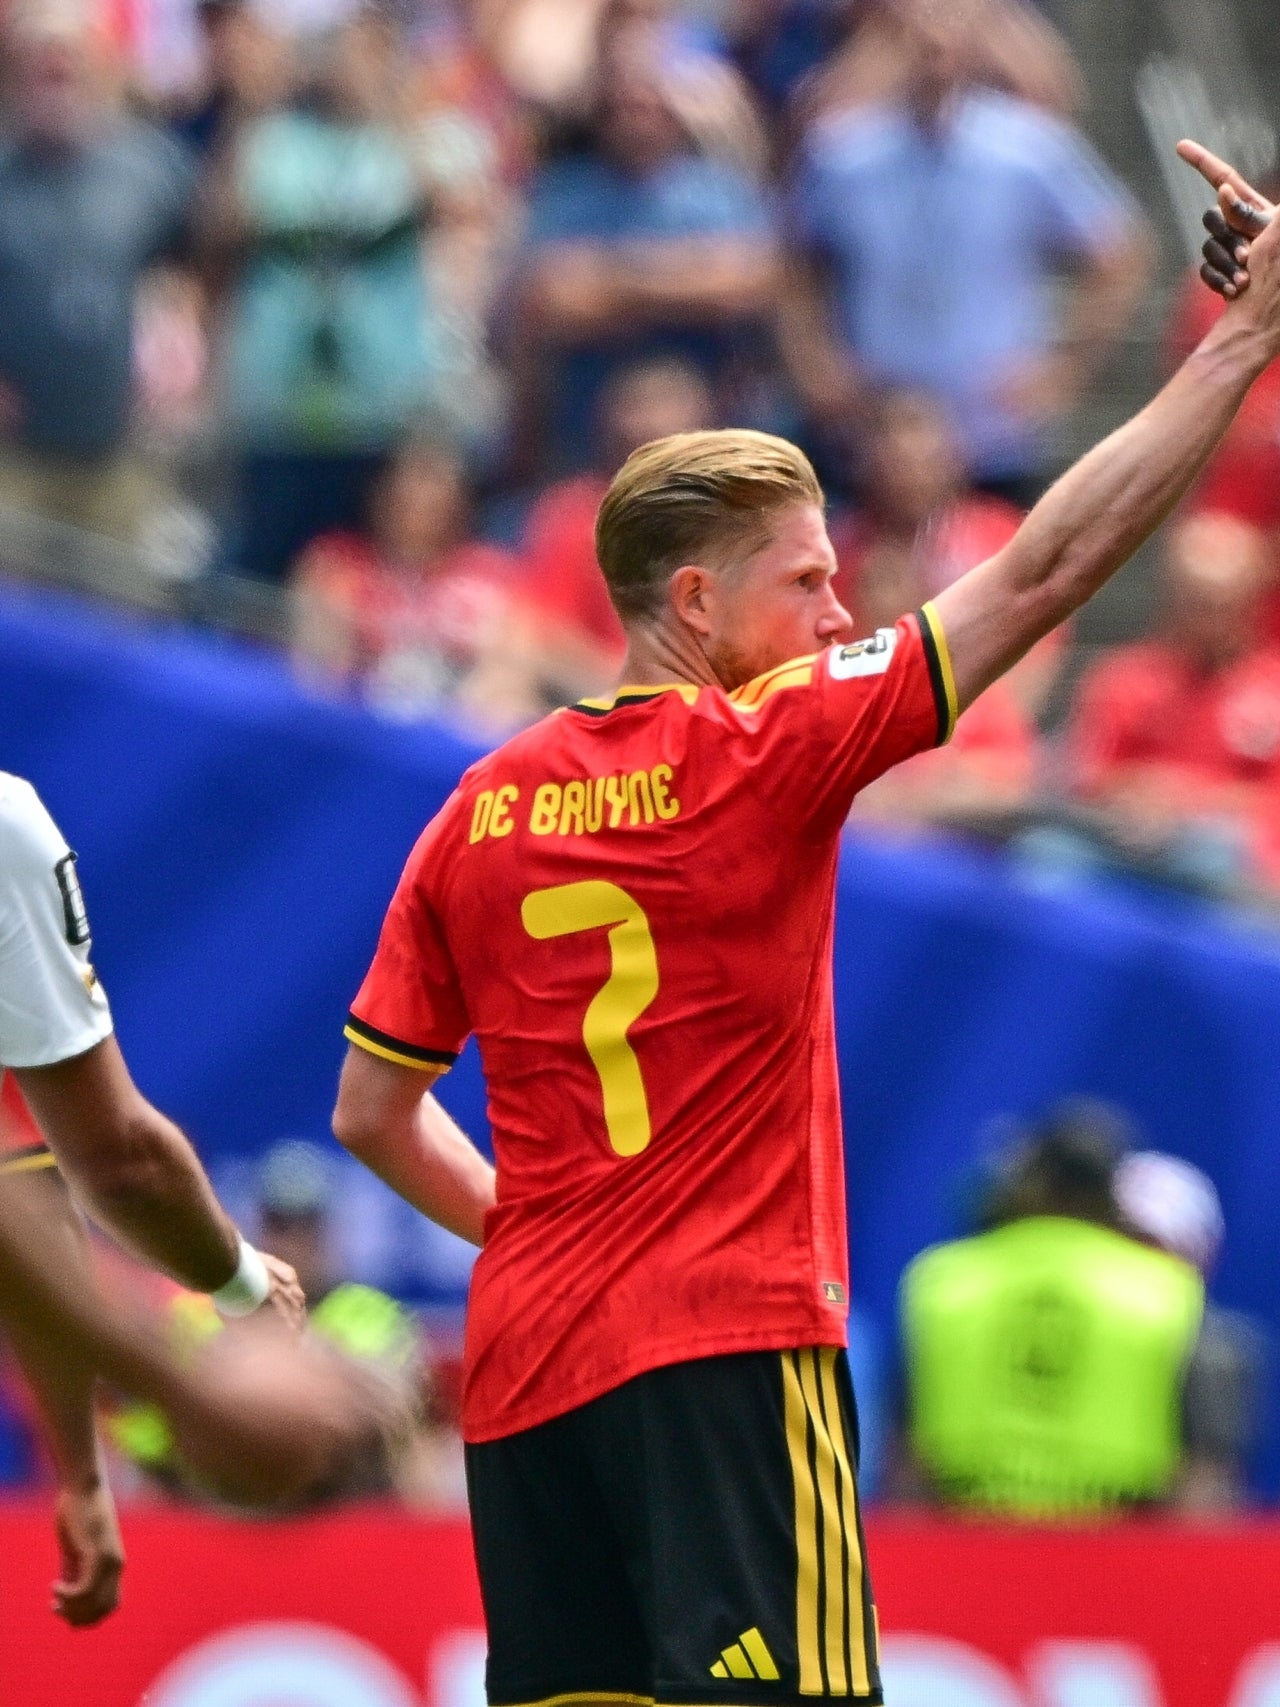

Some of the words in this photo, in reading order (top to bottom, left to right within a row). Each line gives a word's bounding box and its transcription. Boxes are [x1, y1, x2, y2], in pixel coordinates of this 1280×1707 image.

[469, 785, 519, 845] DE
[530, 764, 680, 836] BRUYNE
[520, 880, 659, 1157] 7
